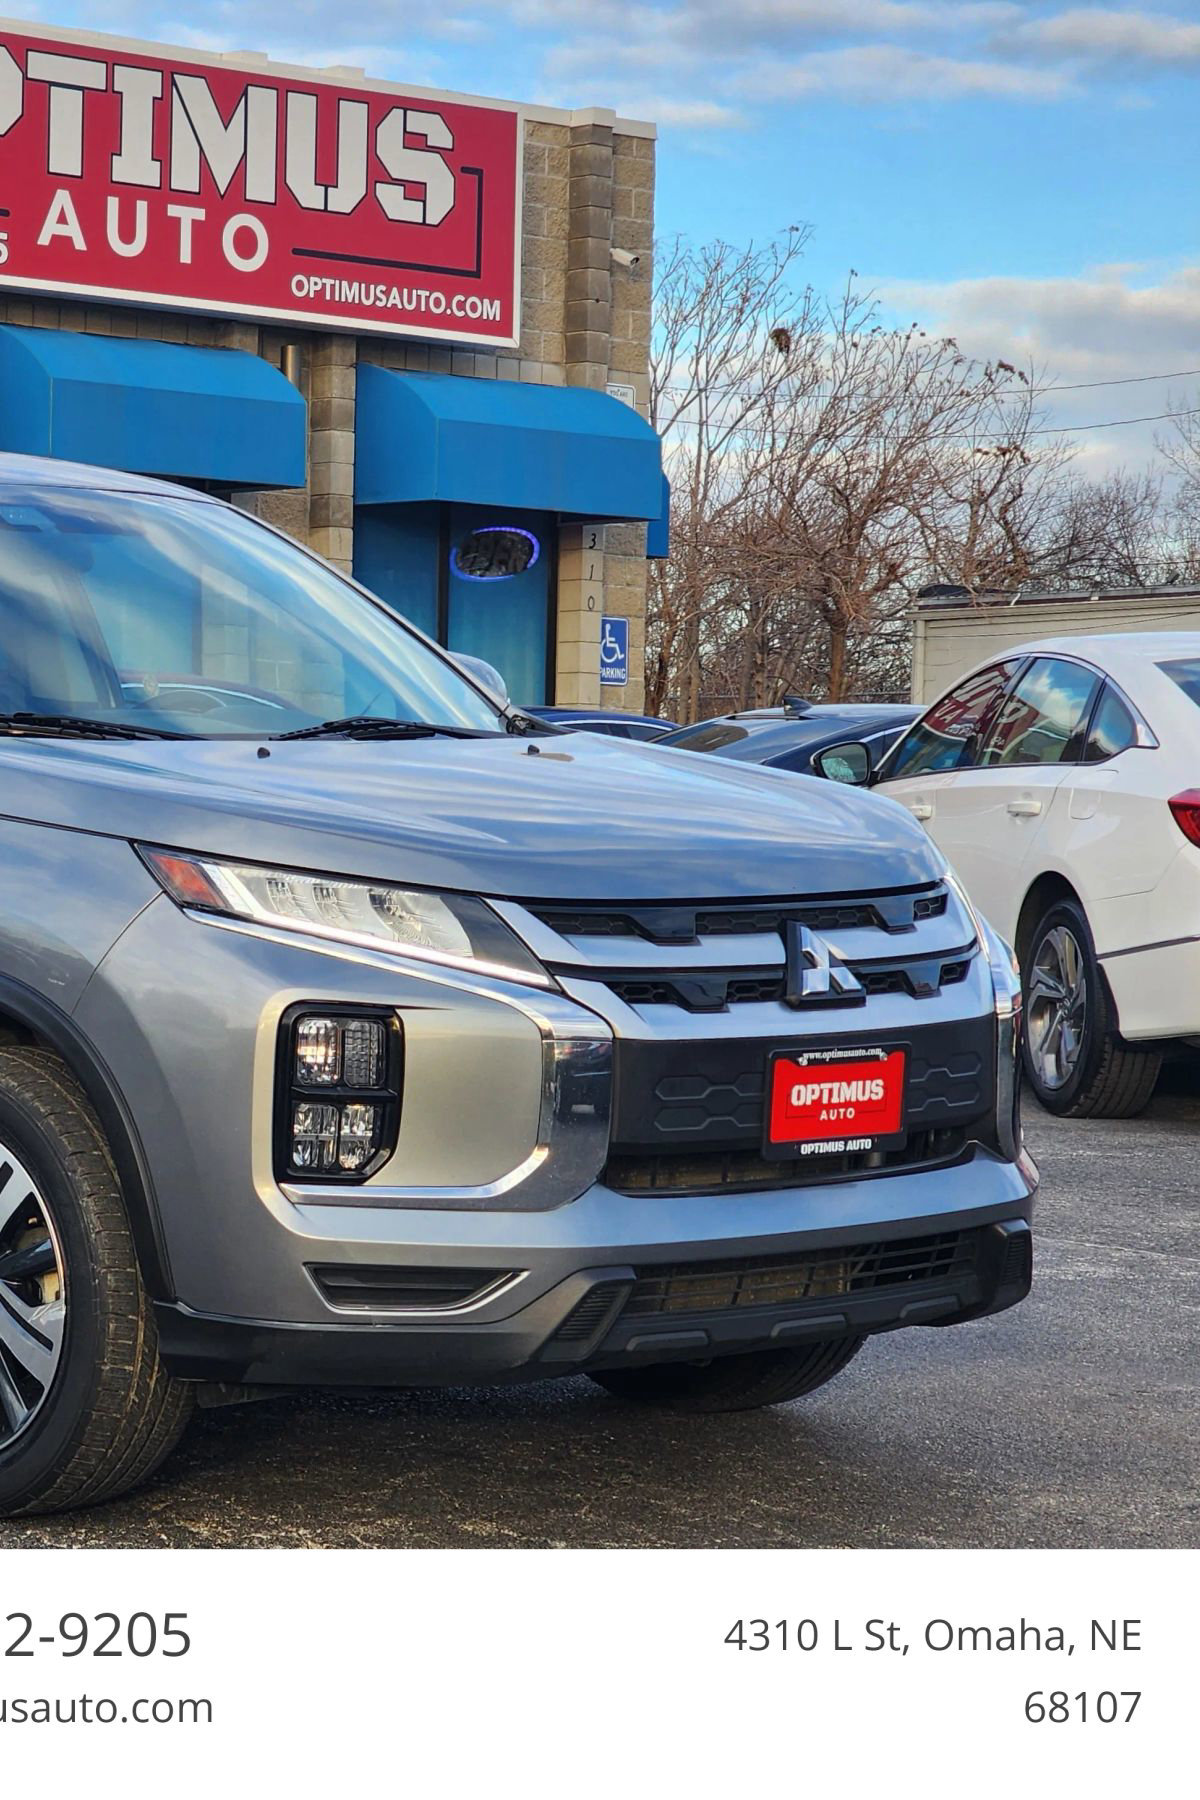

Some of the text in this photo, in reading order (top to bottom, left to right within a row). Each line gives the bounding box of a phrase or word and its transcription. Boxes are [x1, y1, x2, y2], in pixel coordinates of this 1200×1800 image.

[36, 188, 270, 273] AUTO
[290, 273, 502, 323] OPTIMUSAUTO.COM
[803, 1048, 883, 1062] www.optimusauto.com
[791, 1079, 884, 1106] OPTIMUS
[820, 1107, 855, 1121] AUTO
[800, 1139, 872, 1155] OPTIMUS AUTO
